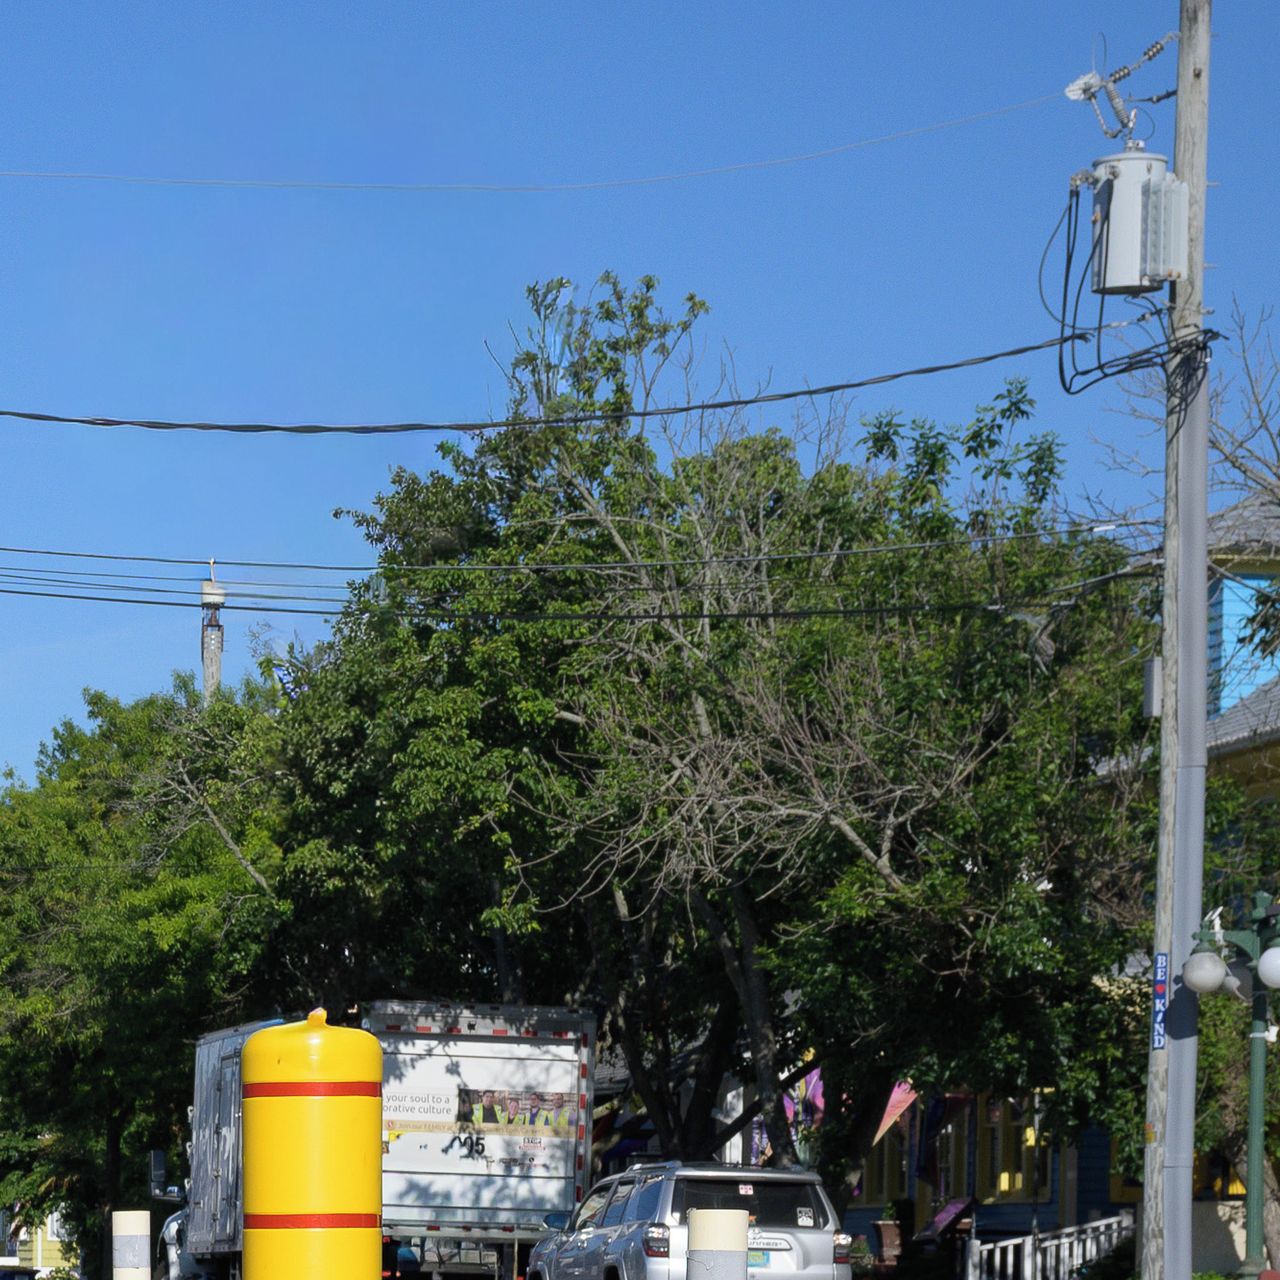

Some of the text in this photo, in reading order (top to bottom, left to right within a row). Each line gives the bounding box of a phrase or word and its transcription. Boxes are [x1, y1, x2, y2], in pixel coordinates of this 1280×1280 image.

[1156, 955, 1167, 980] BE
[386, 1094, 408, 1104] your
[409, 1094, 430, 1103] soul
[431, 1095, 442, 1103] to
[383, 1104, 452, 1114] orative culture
